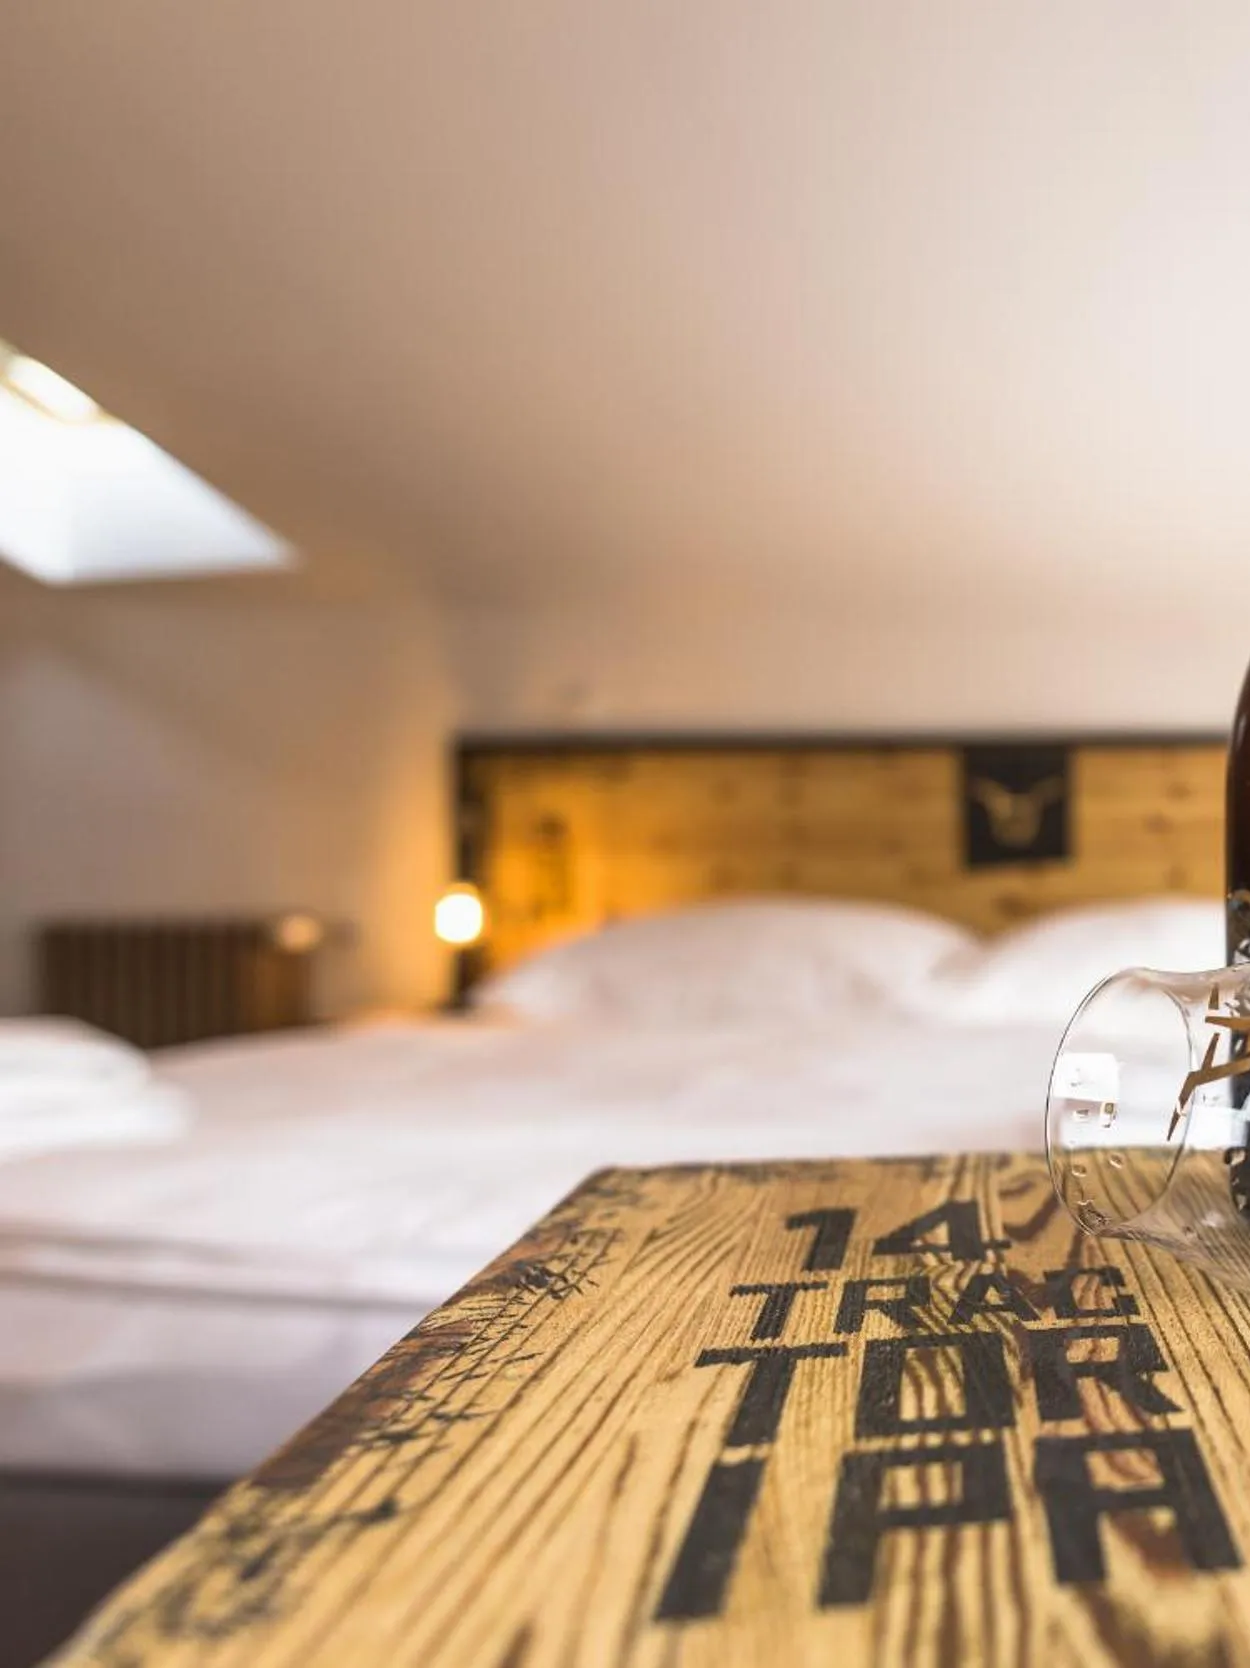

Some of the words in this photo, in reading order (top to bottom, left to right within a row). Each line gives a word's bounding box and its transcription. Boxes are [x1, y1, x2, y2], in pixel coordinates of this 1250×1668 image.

[785, 1200, 1011, 1272] 14
[730, 1266, 1142, 1342] TRAC
[694, 1322, 1188, 1448] TOR
[653, 1427, 1245, 1622] IPA
